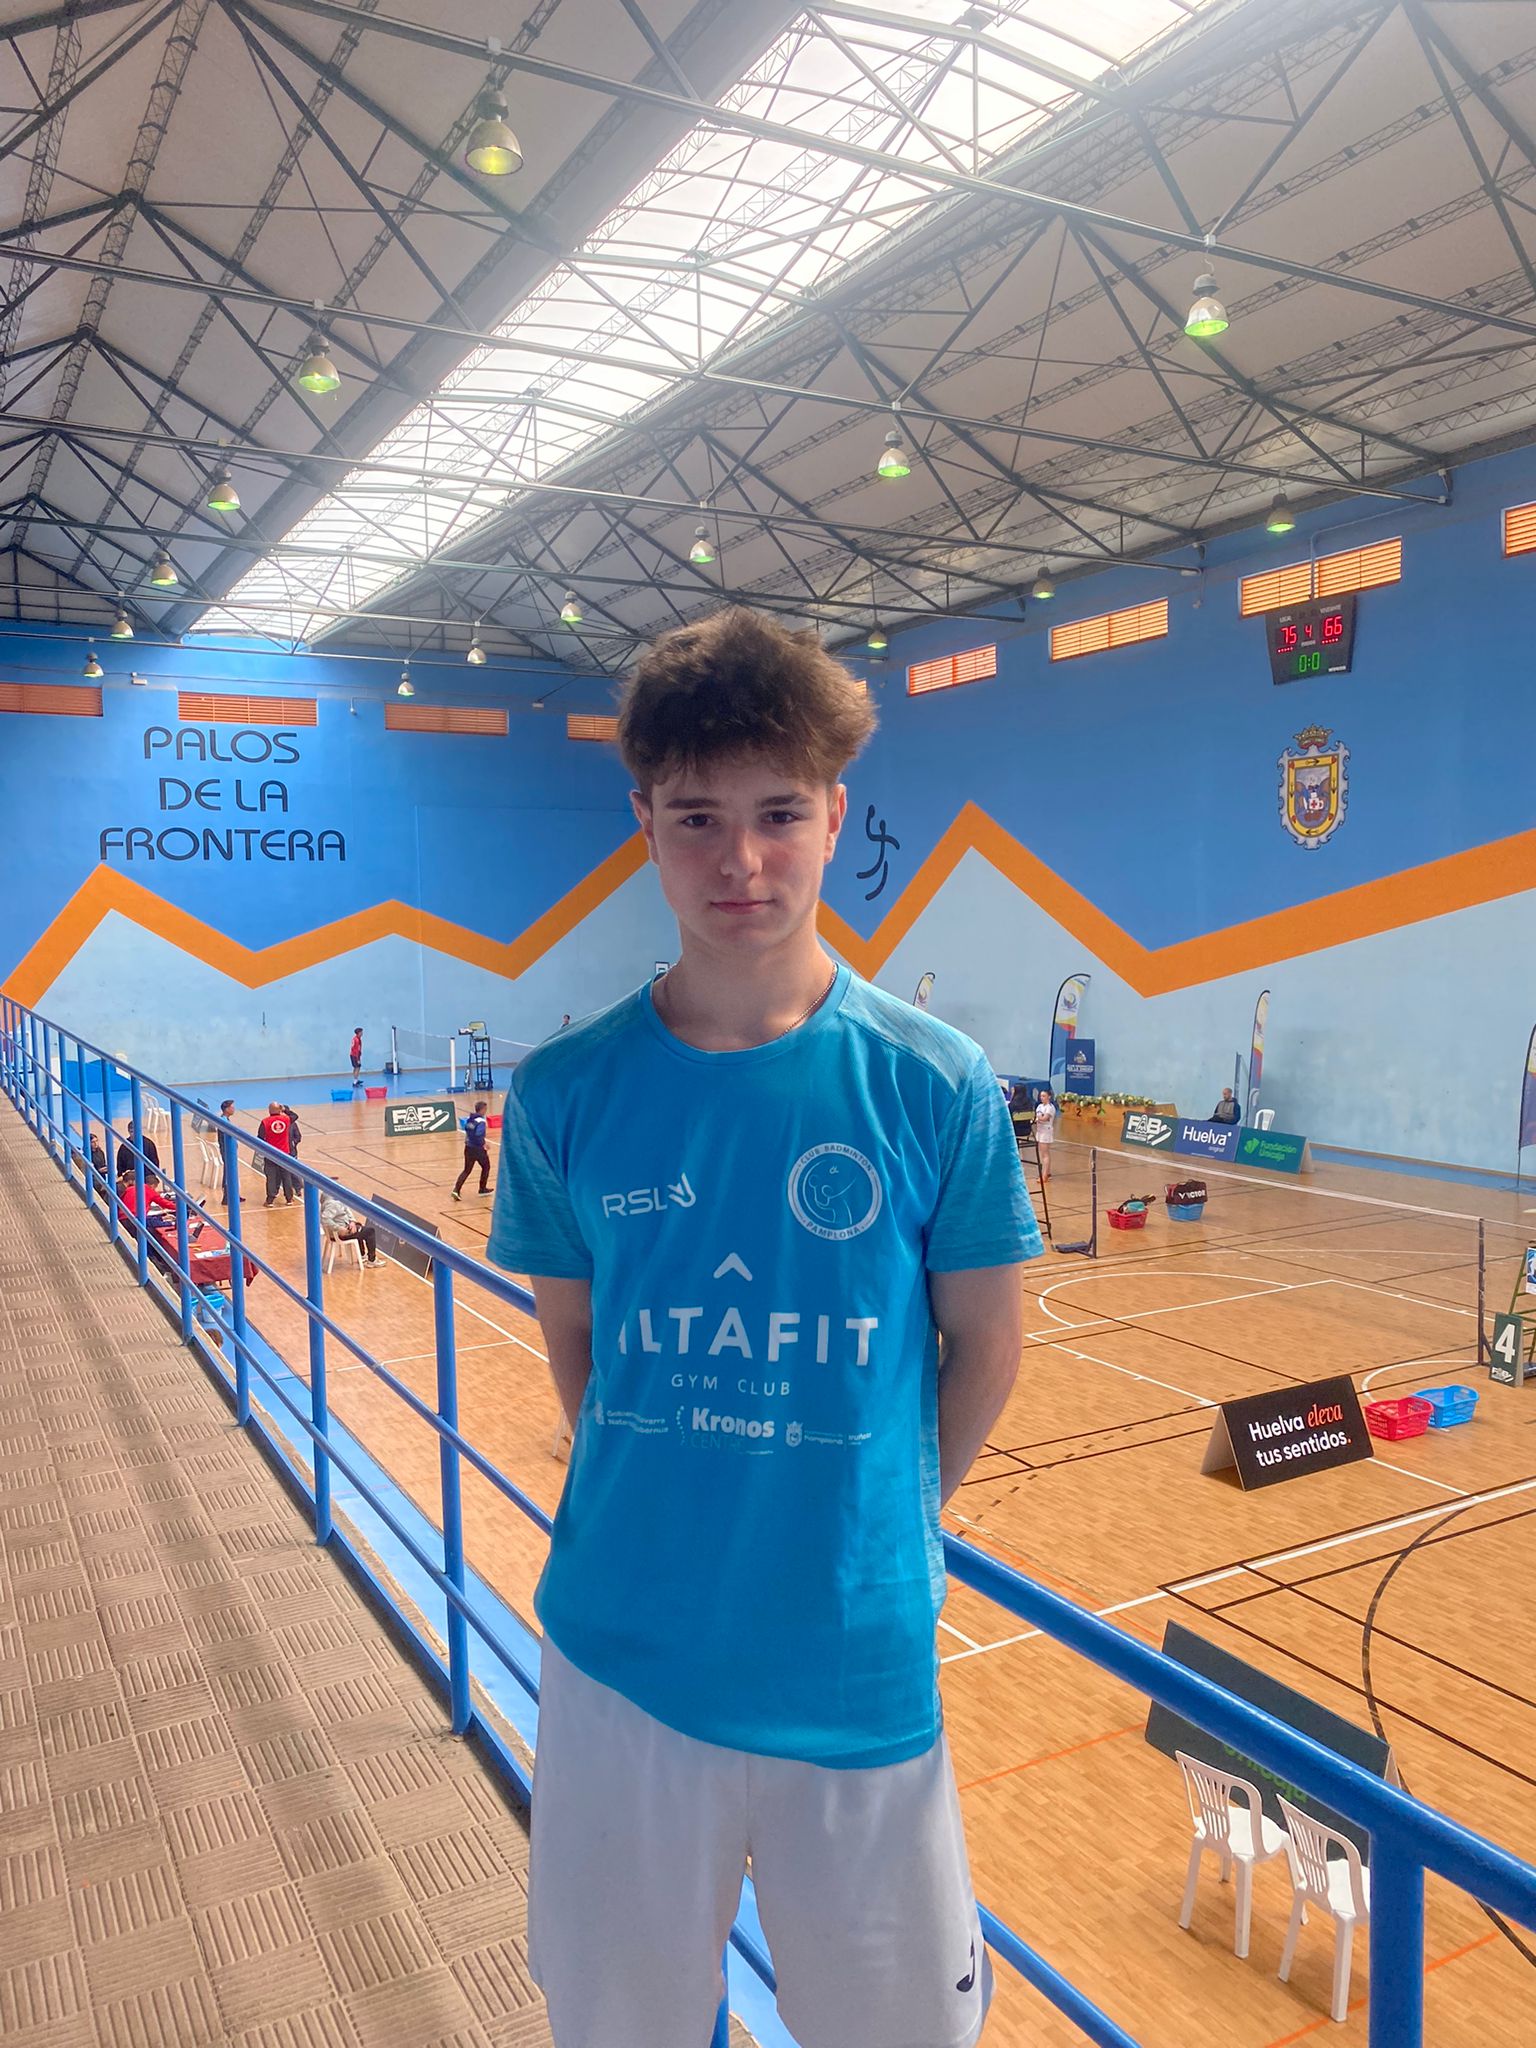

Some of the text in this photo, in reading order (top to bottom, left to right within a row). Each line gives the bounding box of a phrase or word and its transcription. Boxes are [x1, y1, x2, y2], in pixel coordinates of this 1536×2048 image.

[1281, 625, 1297, 644] 75
[1305, 624, 1312, 638] 4
[1324, 615, 1343, 637] 66
[143, 726, 300, 764] PALOS
[159, 777, 289, 813] DE LA
[99, 827, 346, 861] FRONTERA
[1182, 1125, 1227, 1146] Huelva
[800, 1145, 874, 1172] CLUB BADMINTON
[602, 1187, 668, 1219] RSL
[806, 1222, 861, 1240] PAMPLONA
[1495, 1323, 1516, 1363] 4
[671, 1374, 790, 1396] GYM CLUB
[692, 1407, 776, 1438] Kronos
[1248, 1403, 1344, 1442] Huelva eleva
[1256, 1430, 1352, 1467] tus sentidos.
